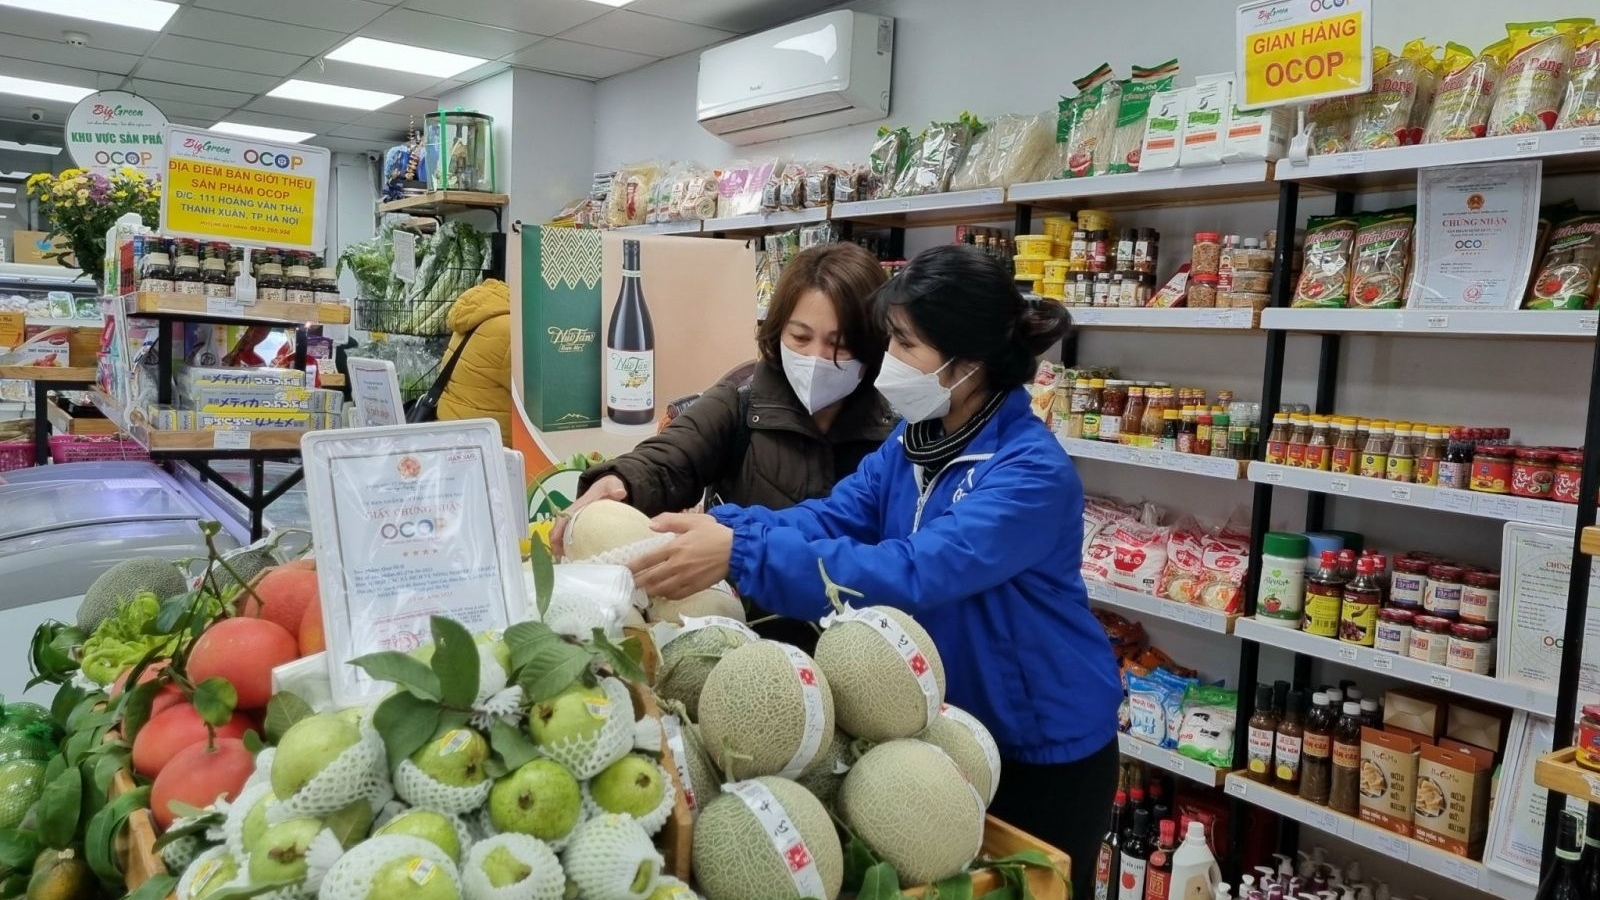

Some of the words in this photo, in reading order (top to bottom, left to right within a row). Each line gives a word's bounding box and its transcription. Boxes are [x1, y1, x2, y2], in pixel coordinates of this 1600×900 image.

[1253, 32, 1295, 54] GIAN
[1301, 19, 1356, 46] HÀNG
[1265, 51, 1344, 87] OCOP
[92, 104, 143, 121] BigGreen
[71, 132, 92, 143] KHU
[95, 132, 116, 145] VỰC
[120, 131, 139, 144] SẢN
[142, 131, 164, 144] PHẨ
[183, 138, 231, 155] BigGreen
[95, 151, 152, 165] OCOP
[243, 149, 303, 170] OCOP
[168, 161, 189, 175] ĐỊA
[254, 172, 278, 184] GIỚI
[191, 178, 216, 191] SẢN
[219, 182, 253, 195] PHẨM
[257, 188, 290, 200] OCOP
[199, 194, 215, 203] 111
[218, 195, 254, 208] HOÀNG
[181, 203, 215, 215] THANH
[251, 212, 263, 221] TP
[1442, 217, 1478, 228] CHỨNG
[1455, 240, 1489, 249] OCO
[219, 397, 259, 408] メディカ
